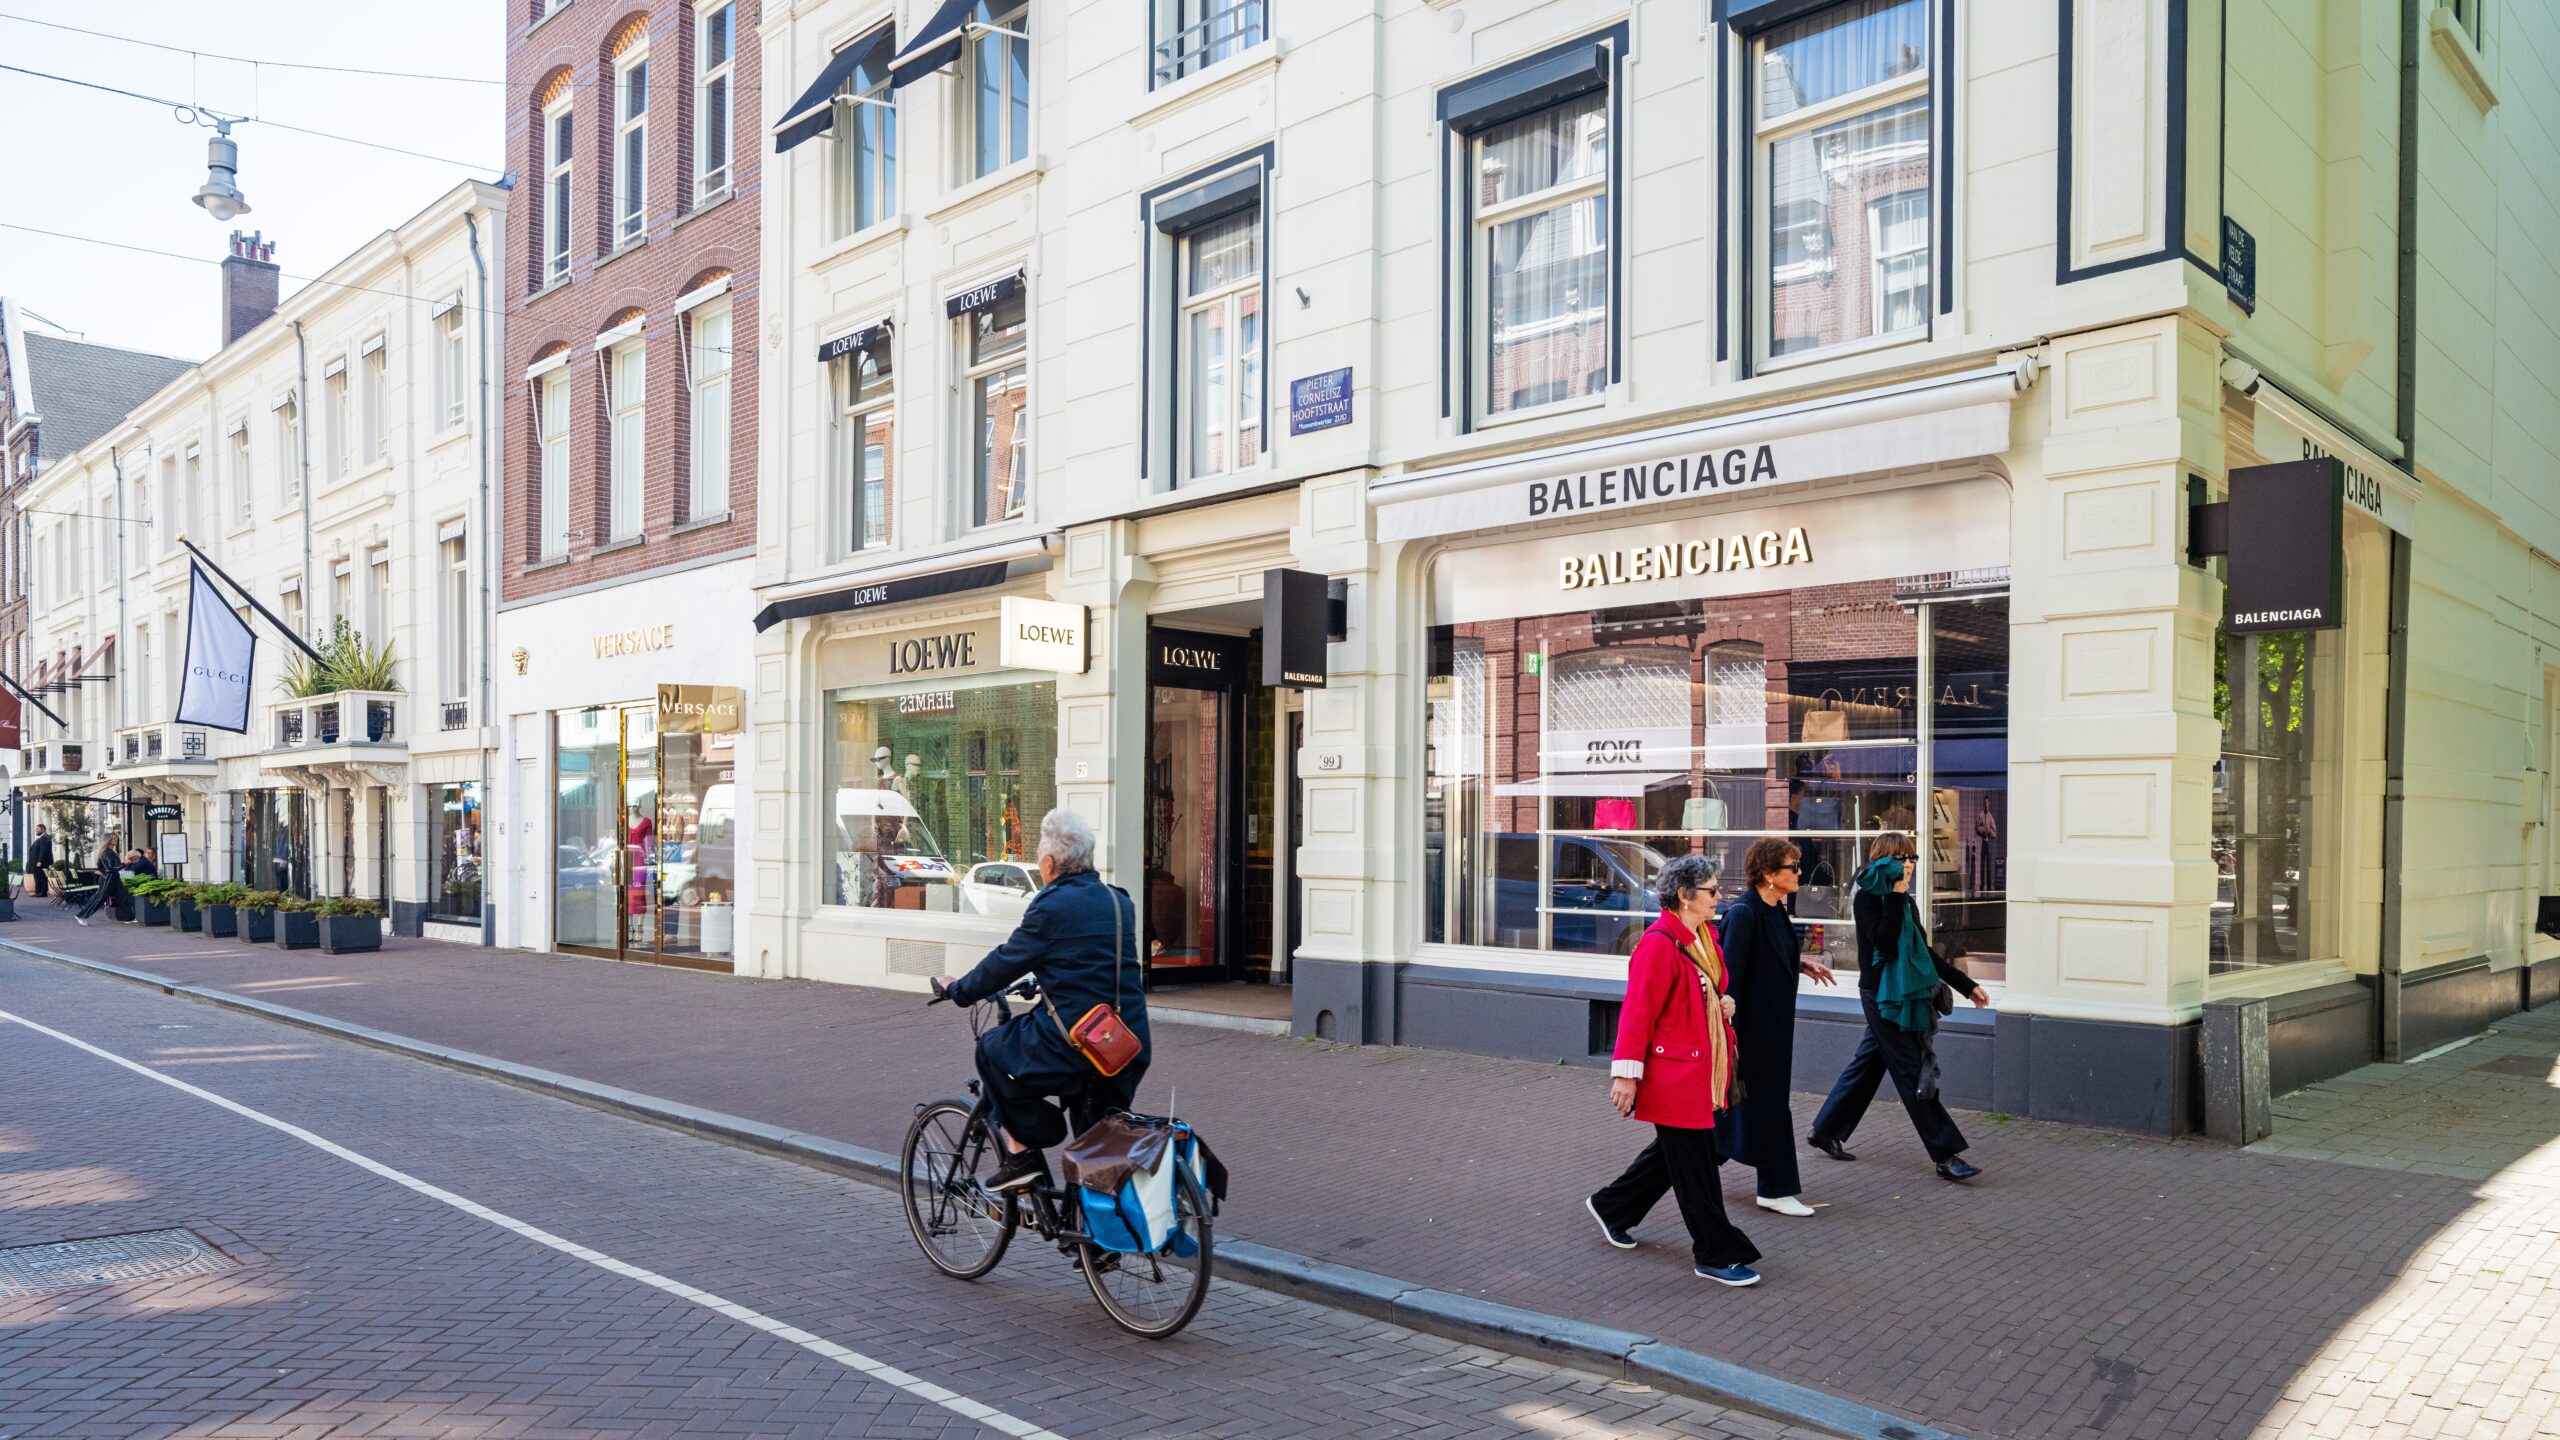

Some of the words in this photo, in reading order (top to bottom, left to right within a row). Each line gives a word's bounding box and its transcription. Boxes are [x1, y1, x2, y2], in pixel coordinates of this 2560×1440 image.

[2227, 221, 2238, 242] VAN
[2238, 229, 2245, 248] DE
[2227, 265, 2244, 289] STRAAT
[960, 284, 998, 312] LOEWE
[832, 332, 865, 356] LOEWE
[1307, 375, 1334, 391] PIETER
[1298, 386, 1342, 407] CORNELISZ
[1292, 399, 1350, 422] HOOFTSTRAAT
[1529, 444, 1778, 516] BALENCIAGA
[1559, 527, 1813, 590] BALENCIAGA
[854, 585, 888, 605] LOEWE
[2235, 608, 2322, 625] BALENCIAGA
[593, 623, 674, 659] VERSACE
[1019, 623, 1075, 646] LOEWE
[890, 631, 976, 674] LOEWE
[1163, 646, 1221, 670] LOEWE
[193, 666, 245, 685] GUCCI
[1284, 671, 1323, 684] BALENCIAGA
[661, 702, 737, 716] VERSACE
[1077, 763, 1087, 775] 97
[1323, 756, 1335, 767] 99
